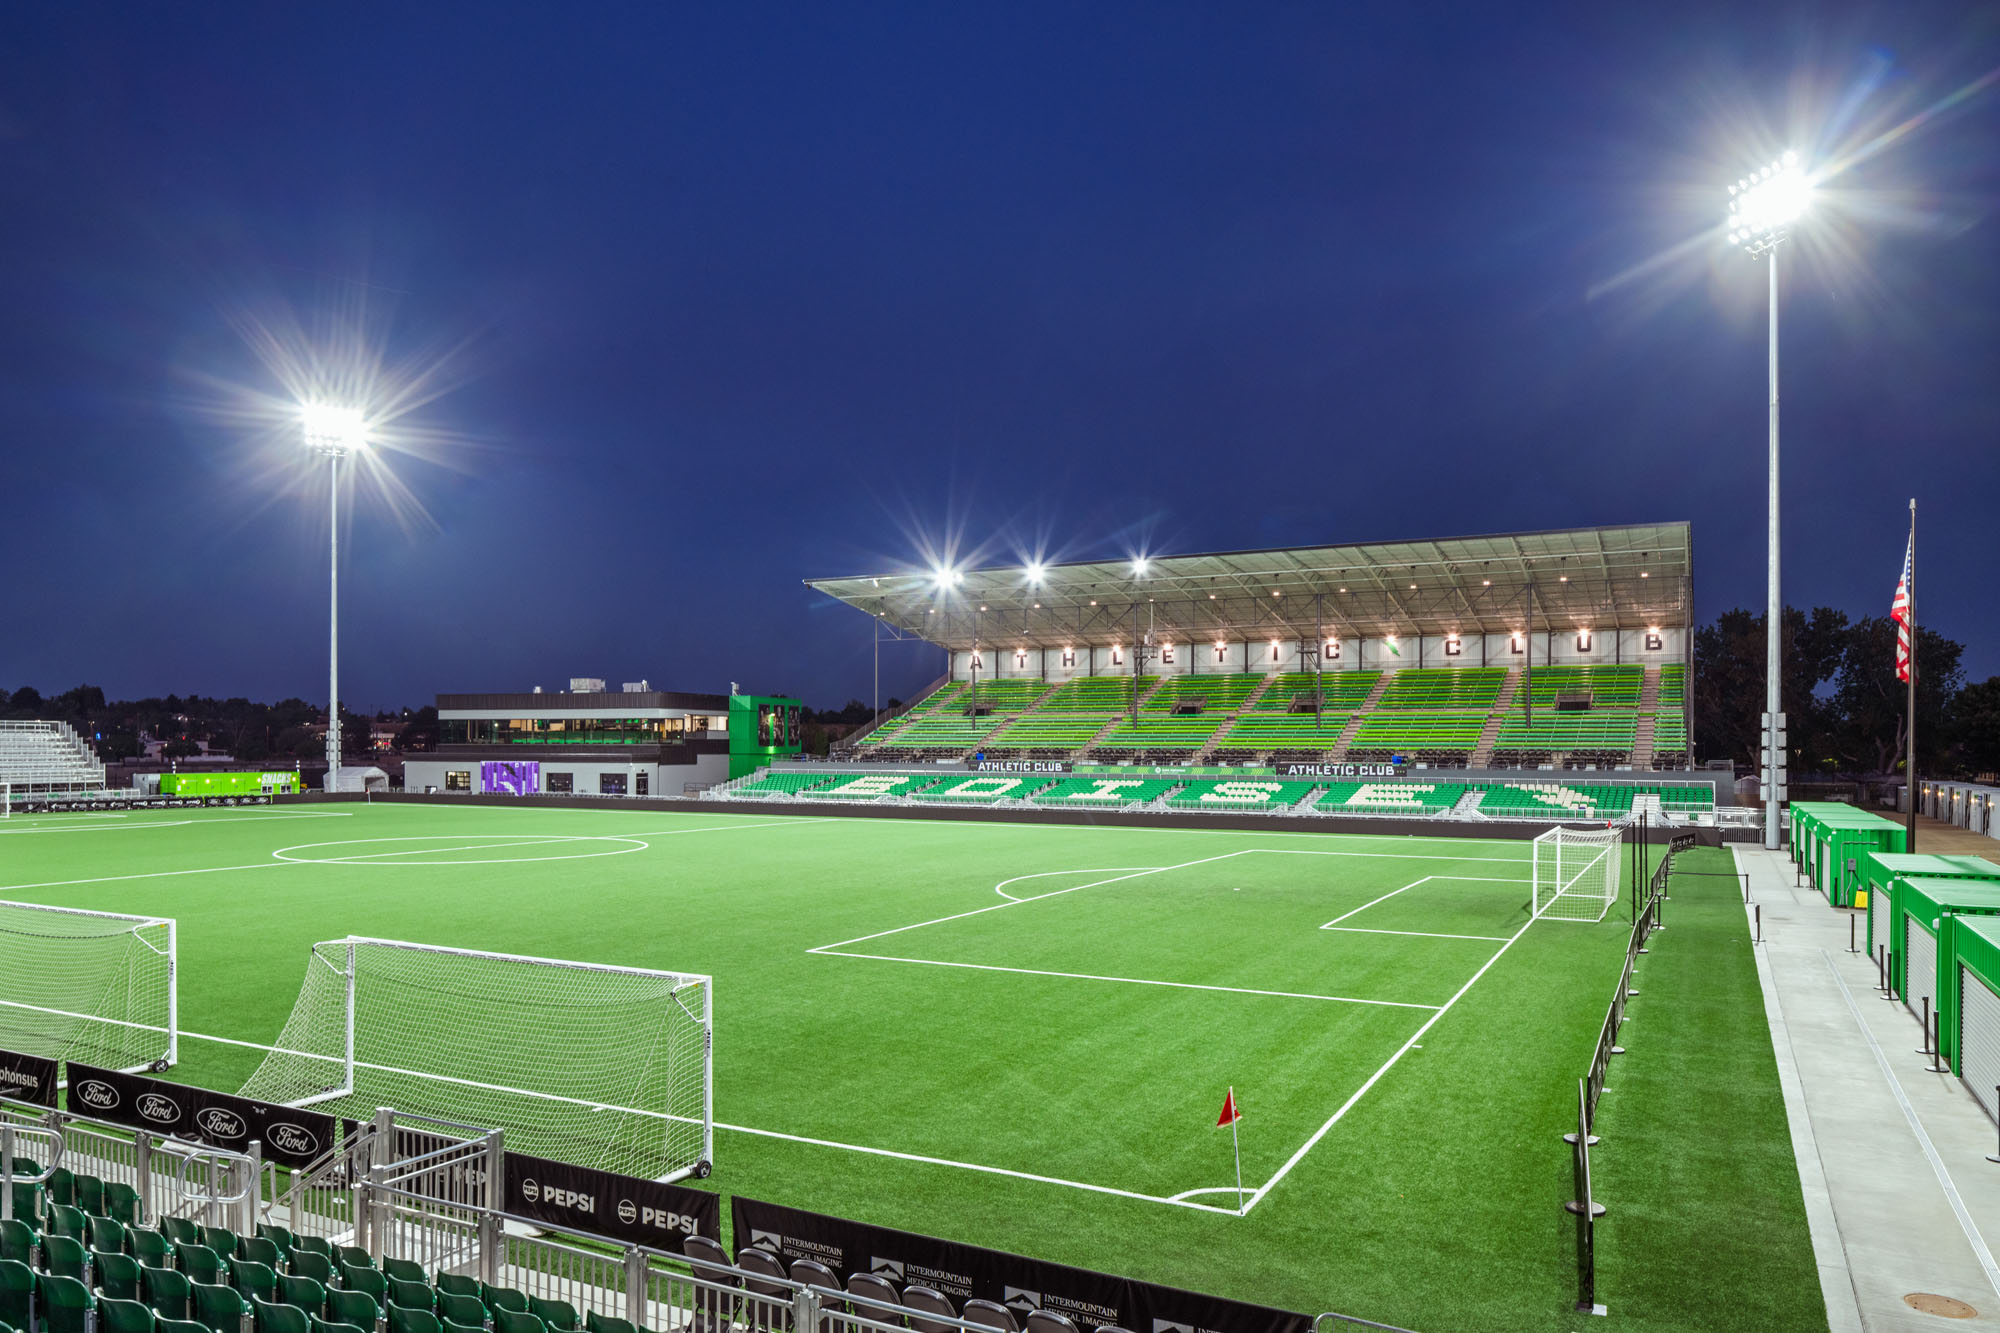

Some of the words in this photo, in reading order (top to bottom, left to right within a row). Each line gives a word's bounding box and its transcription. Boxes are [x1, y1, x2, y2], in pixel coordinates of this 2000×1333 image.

[978, 762, 1031, 771] ATHLETIC
[1034, 762, 1063, 771] CLUB
[1288, 765, 1355, 775] ATHLETIC
[1359, 766, 1395, 775] CLUB
[261, 773, 292, 784] SNACKS
[85, 1083, 112, 1106] Ford
[144, 1097, 173, 1120] Ford
[207, 1111, 238, 1135] Ford
[276, 1126, 309, 1151] Ford
[524, 1187, 538, 1195] PEPSI
[543, 1185, 595, 1213] PEPSI
[619, 1207, 635, 1215] PEPSI
[642, 1206, 699, 1235] PEPSI
[783, 1236, 842, 1256] INTERMOUNTAIN
[783, 1247, 812, 1260] MEDICAL
[813, 1255, 842, 1268] IMAGING
[906, 1263, 972, 1285] INTERMOUNTAIN
[906, 1276, 939, 1289] MEDICAL
[940, 1283, 972, 1298] IMAGING
[1044, 1293, 1117, 1317] INTERMOUNTAIN
